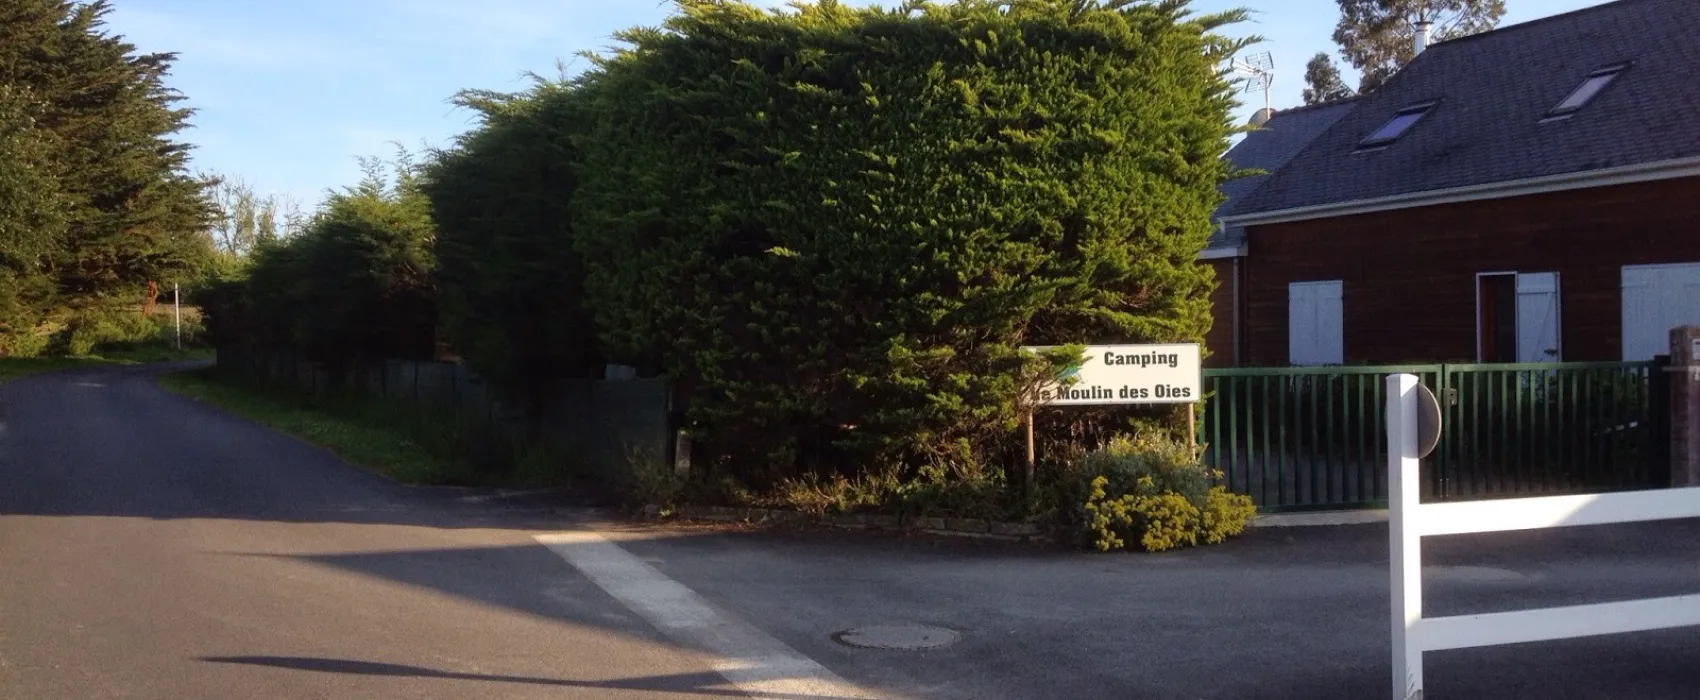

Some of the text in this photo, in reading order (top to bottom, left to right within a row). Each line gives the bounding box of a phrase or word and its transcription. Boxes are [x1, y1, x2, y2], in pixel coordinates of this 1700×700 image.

[1104, 351, 1178, 368] Camping
[1057, 386, 1113, 400] Moulin
[1119, 385, 1149, 399] des
[1155, 384, 1191, 398] Oies
